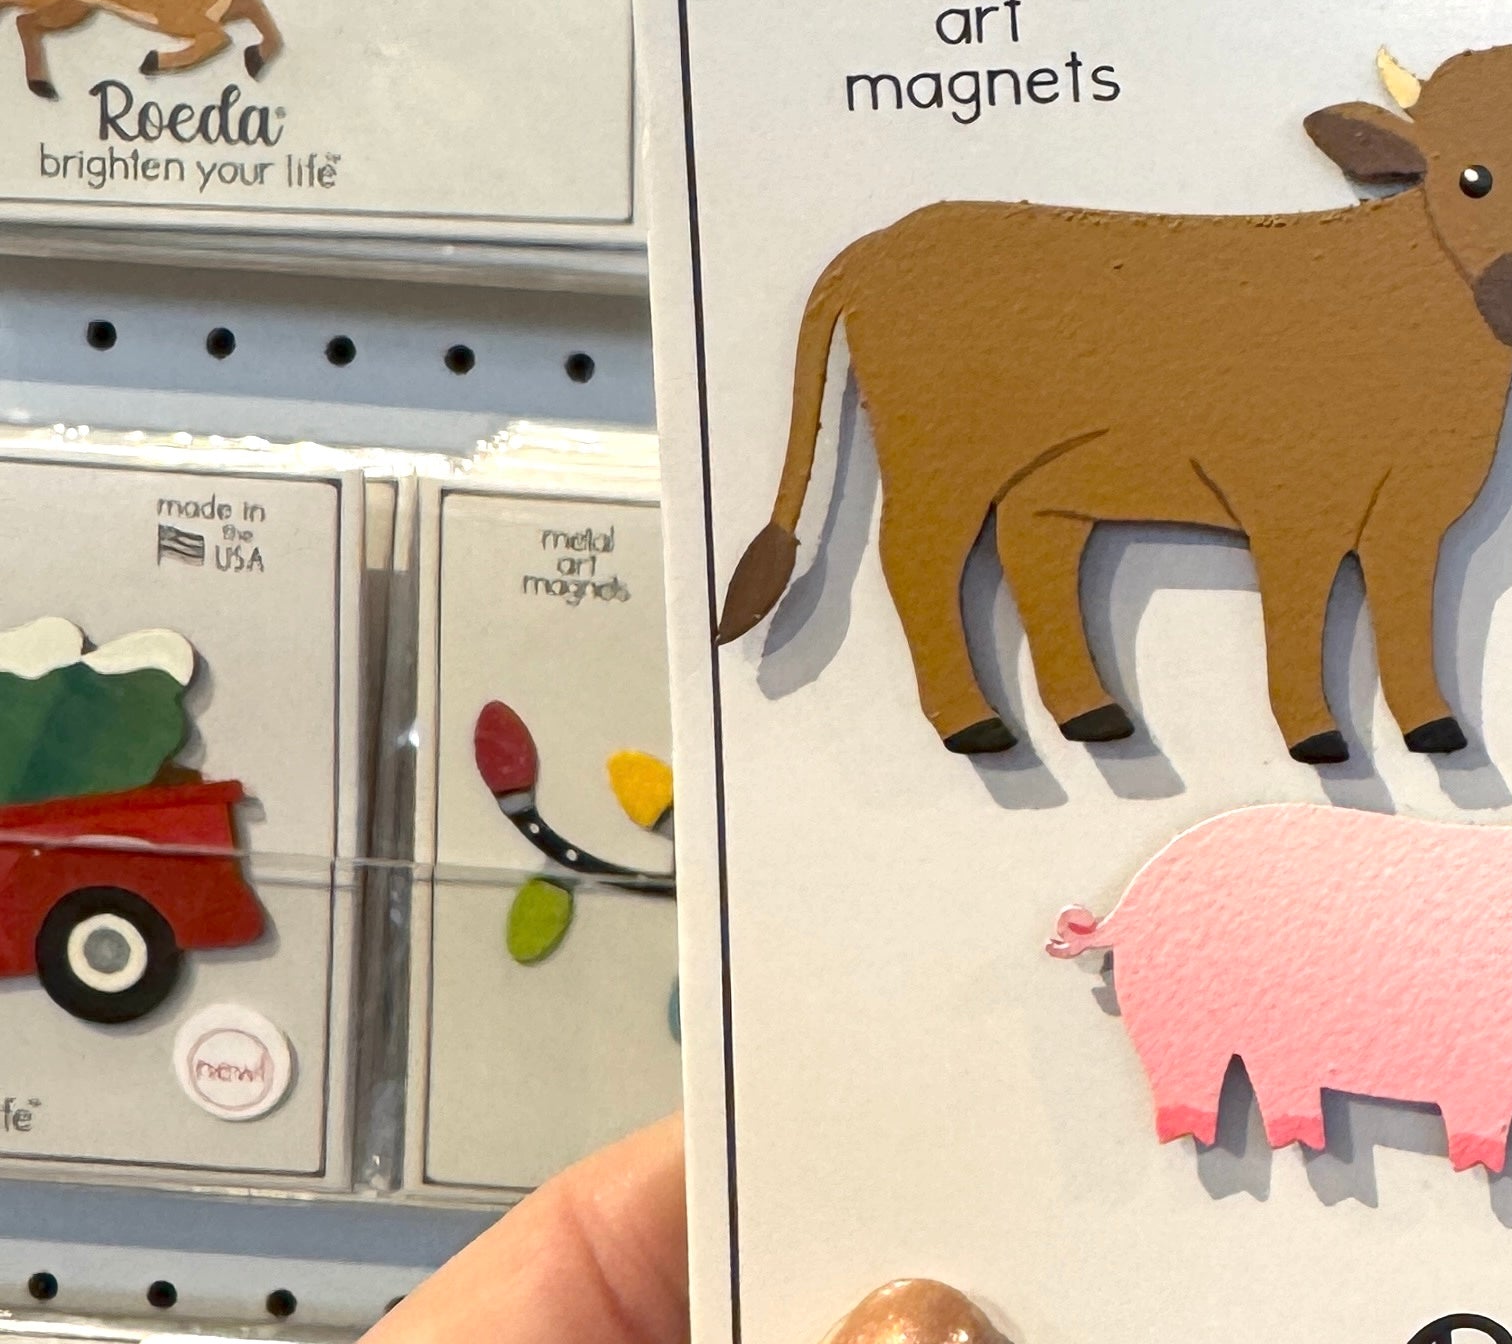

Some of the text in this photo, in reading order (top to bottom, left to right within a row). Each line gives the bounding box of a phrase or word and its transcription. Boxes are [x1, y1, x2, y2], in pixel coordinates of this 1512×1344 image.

[846, 51, 1121, 124] magnets
[39, 142, 185, 190] brighten
[196, 159, 275, 194] your
[157, 492, 232, 520] made
[541, 525, 615, 552] metal
[215, 545, 264, 573] USA
